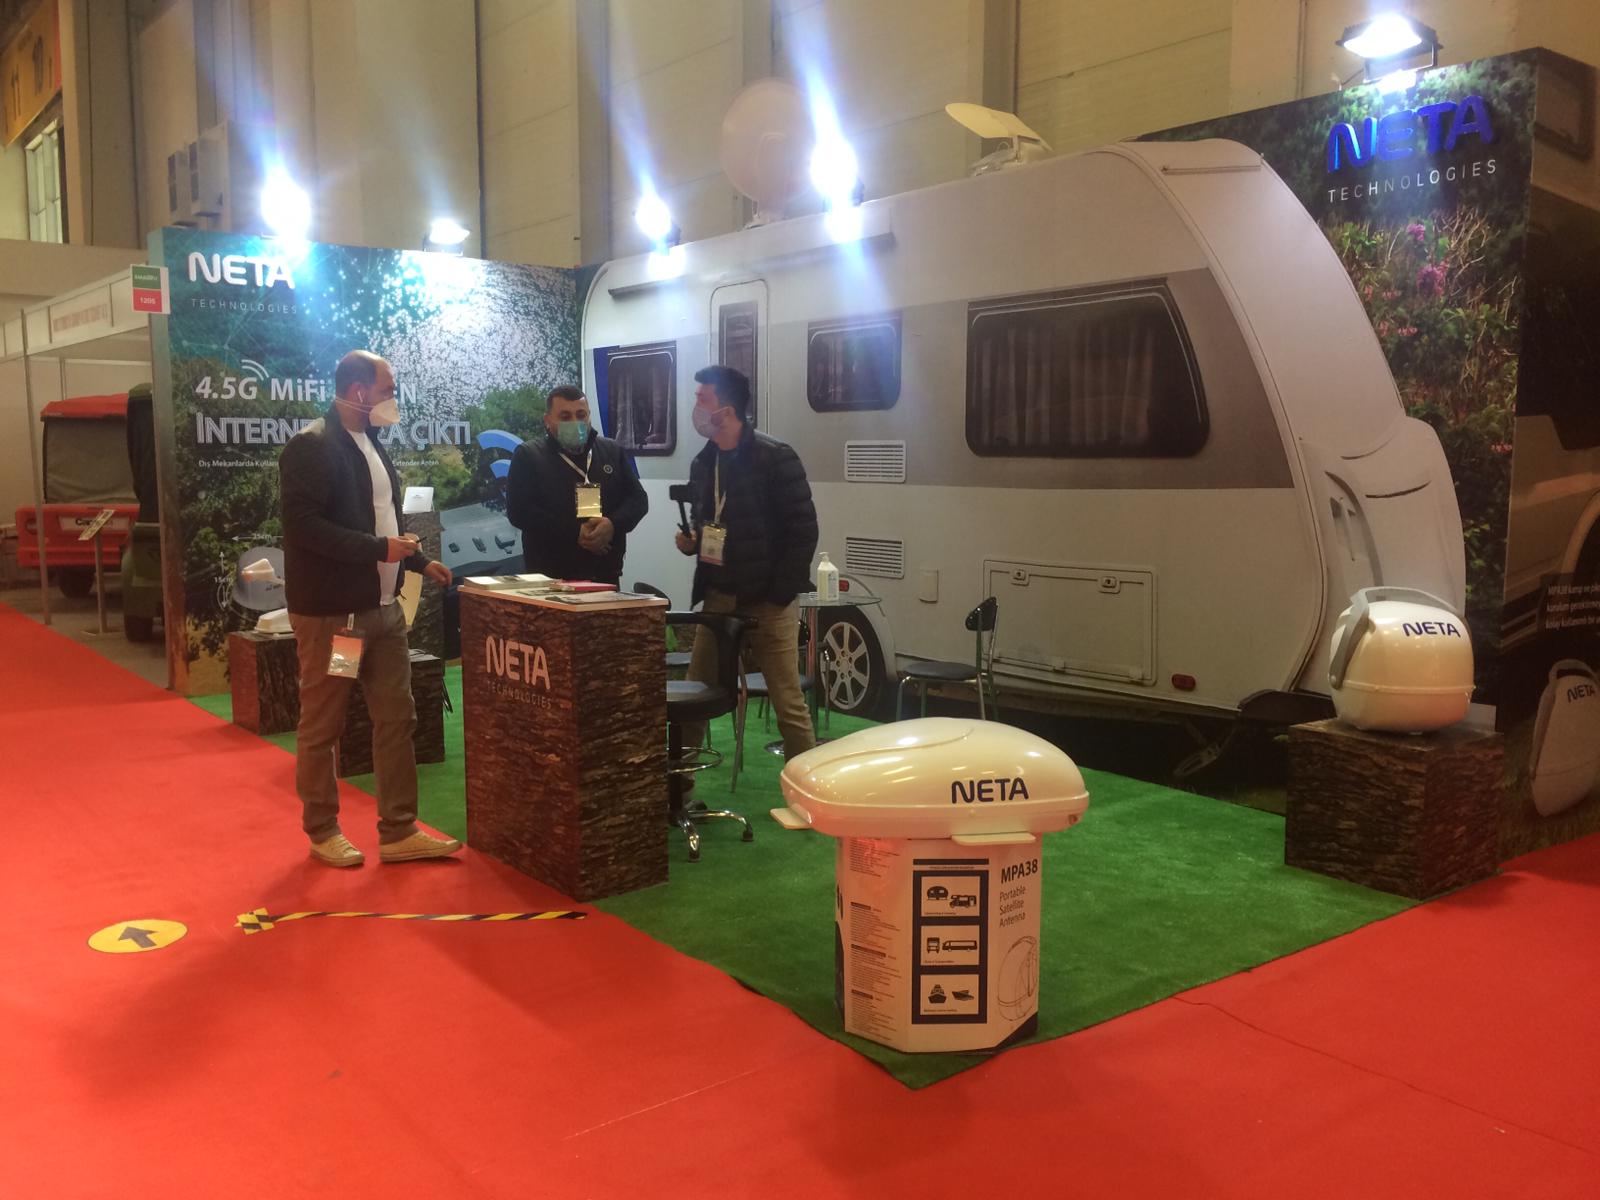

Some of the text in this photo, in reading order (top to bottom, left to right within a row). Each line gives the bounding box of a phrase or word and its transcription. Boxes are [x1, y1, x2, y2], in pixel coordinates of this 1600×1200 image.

[1328, 95, 1493, 173] NETA
[1328, 159, 1497, 203] TECHNOLOGIES
[188, 251, 296, 290] NETA
[192, 298, 297, 314] TECHNOLOGIES
[195, 375, 258, 400] 4.5G
[271, 377, 326, 402] MiFi
[411, 419, 471, 451] ÇIKTI
[1402, 622, 1461, 638] NETA
[485, 635, 551, 690] NETA
[487, 680, 551, 710] TECHNOLOGIES
[1567, 684, 1596, 704] NETA
[951, 777, 1029, 804] NETA
[1001, 858, 1038, 884] MPA38
[1000, 885, 1026, 902] Portable
